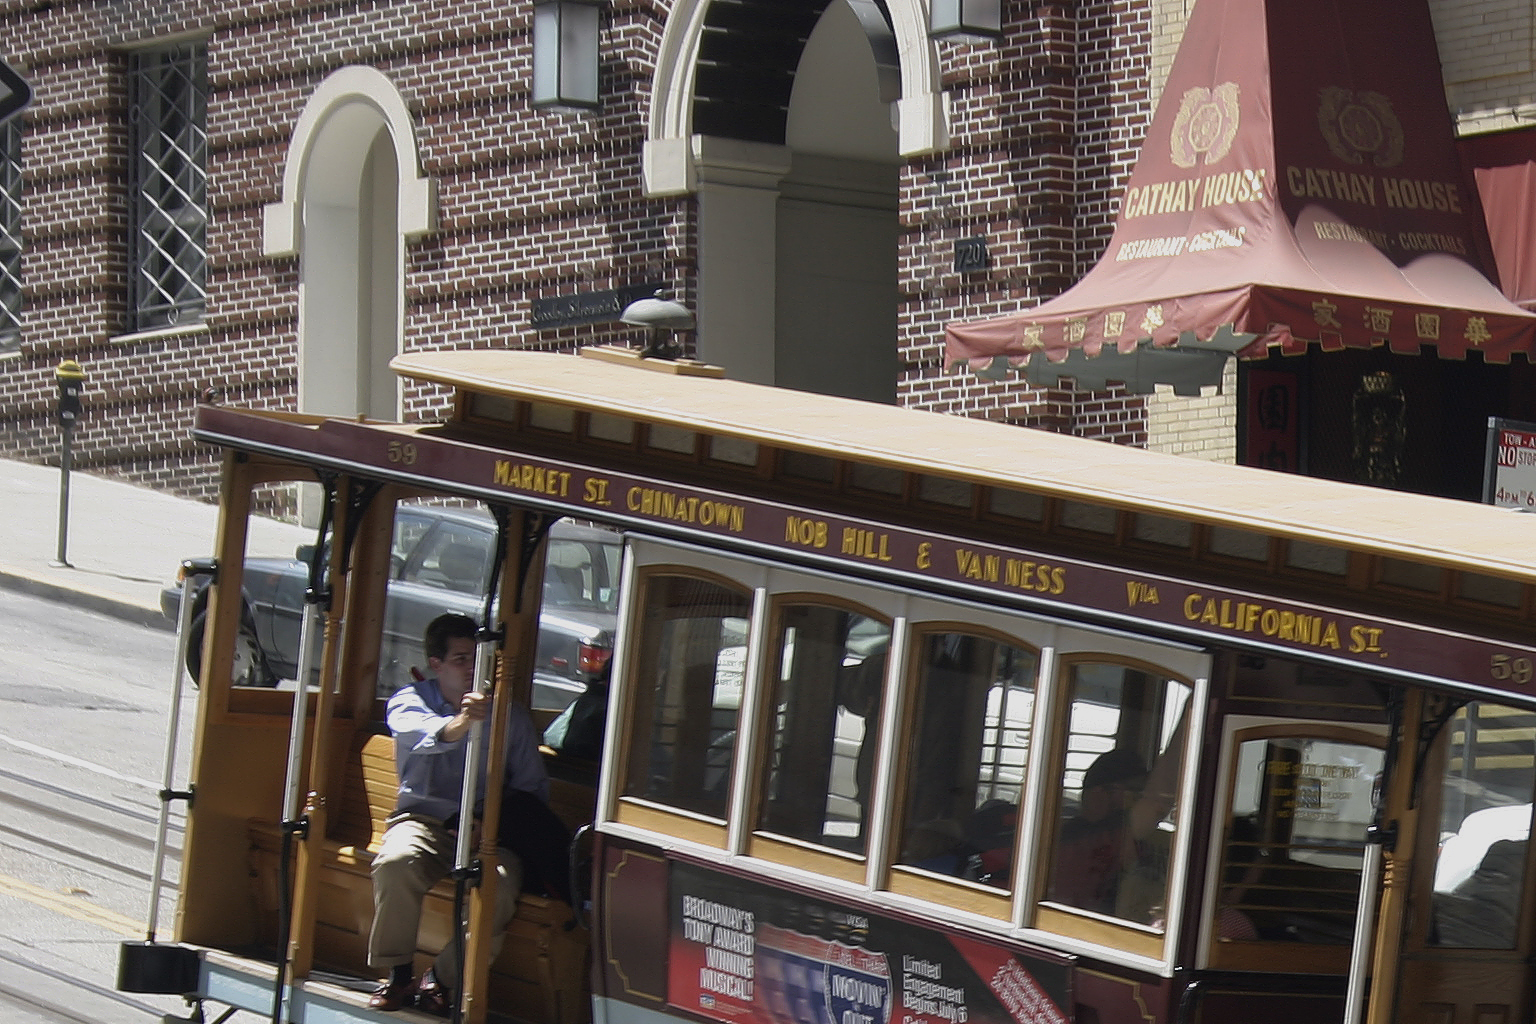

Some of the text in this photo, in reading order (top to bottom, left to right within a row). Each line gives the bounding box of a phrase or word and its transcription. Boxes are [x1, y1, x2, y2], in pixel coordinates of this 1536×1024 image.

[1124, 168, 1267, 219] CATHAY HOUSE
[1286, 166, 1463, 214] CATHAY HOUSE
[1116, 237, 1187, 262] RESTAURANT
[1313, 221, 1466, 256] RESTAURANT COCKTAILS
[387, 440, 417, 465] 59
[1497, 445, 1516, 465] NO
[493, 459, 571, 497] MARKET
[627, 486, 745, 532] CHINATOWN
[785, 515, 829, 549] NOB
[841, 526, 892, 561] HILL
[916, 542, 932, 570] &
[955, 548, 1000, 583] VAN
[1004, 558, 1066, 595] NESS
[1183, 593, 1341, 650] CALIFORNIA
[1490, 653, 1533, 684] 59
[683, 895, 754, 933] BROADWAY'S
[713, 926, 754, 955] AWARD
[705, 946, 754, 979] WINNING
[902, 954, 941, 980] Limited
[902, 973, 965, 1004] Engagement
[903, 991, 968, 1024] Begins July 6
